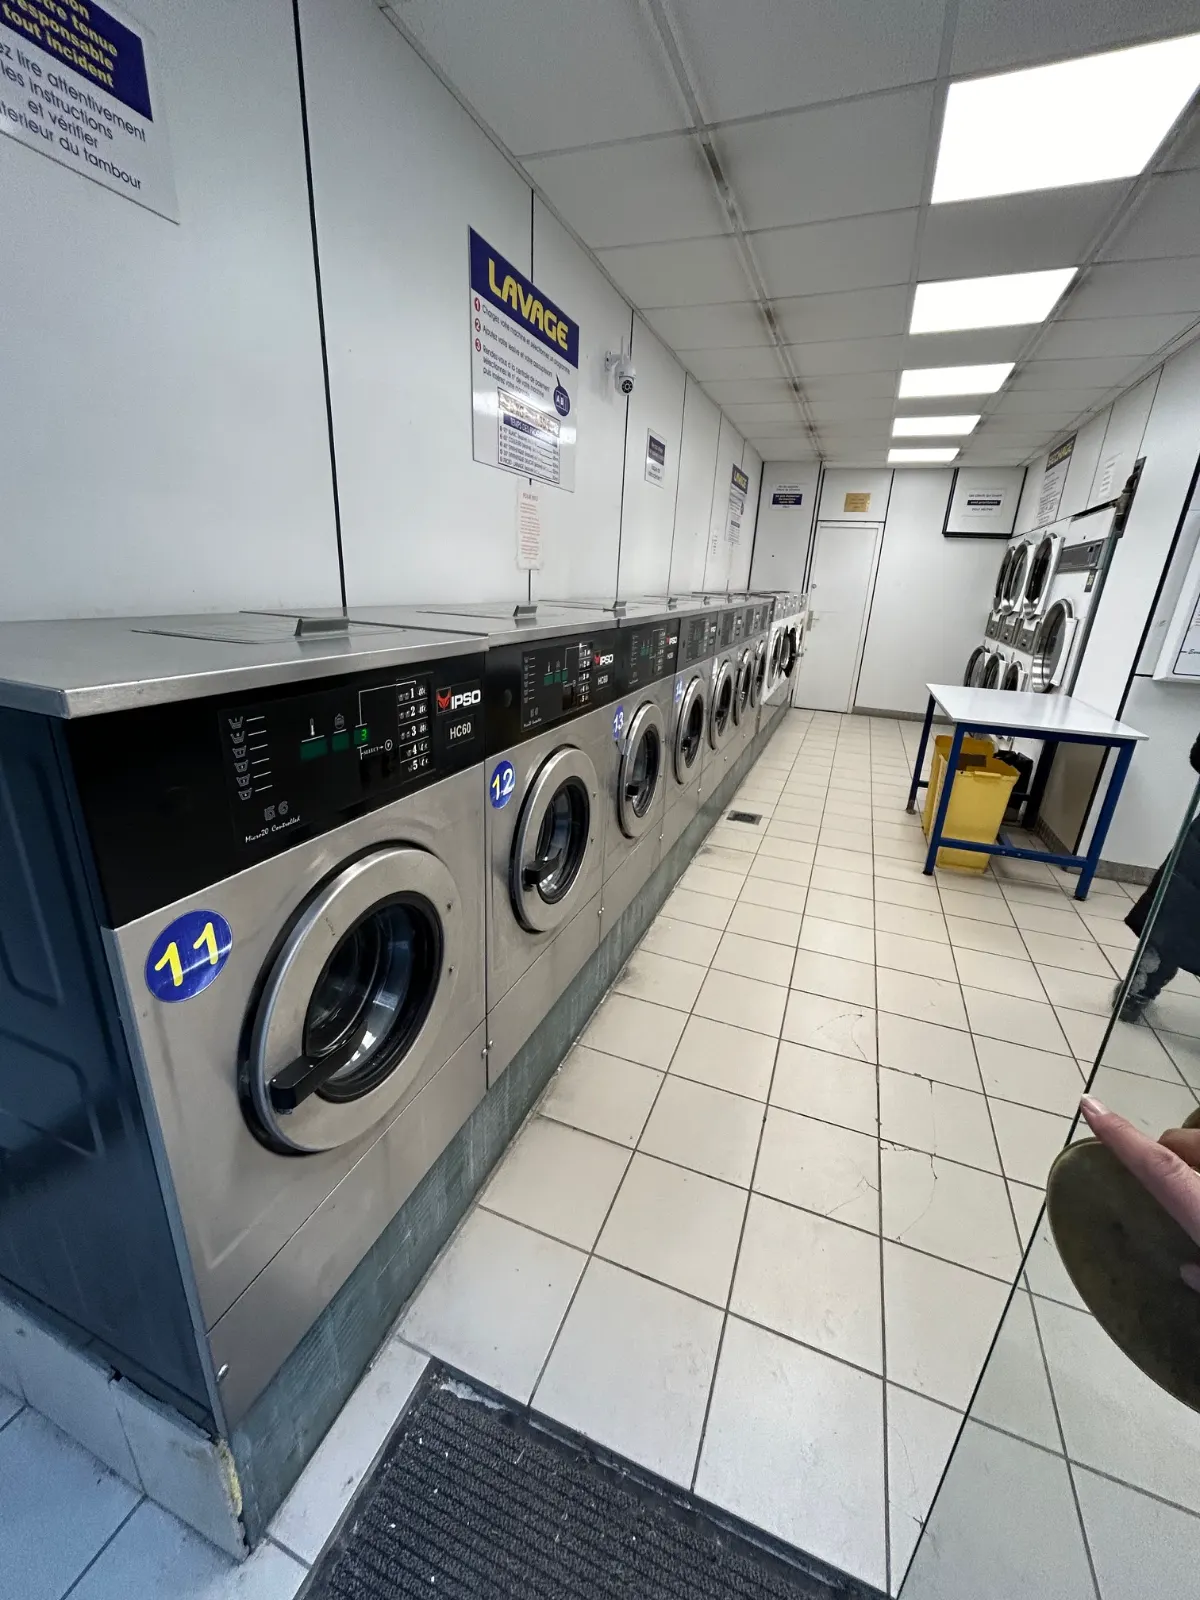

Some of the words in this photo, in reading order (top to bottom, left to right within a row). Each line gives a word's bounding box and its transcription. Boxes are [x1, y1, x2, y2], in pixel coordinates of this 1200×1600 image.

[2, 3, 42, 40] tout
[45, 29, 114, 88] incident
[11, 0, 114, 71] esponsable
[71, 14, 118, 57] tenue
[17, 48, 42, 78] lire
[47, 73, 146, 142] attentivement
[29, 77, 114, 140] instructions
[28, 100, 44, 119] et
[48, 110, 98, 148] vérifier
[59, 137, 79, 156] du
[84, 148, 141, 189] tambour
[488, 257, 569, 351] LAVAGE
[451, 689, 481, 710] IPSO
[613, 711, 624, 732] 13
[449, 722, 472, 740] HC60
[492, 767, 515, 801] 12
[154, 922, 219, 987] 11
